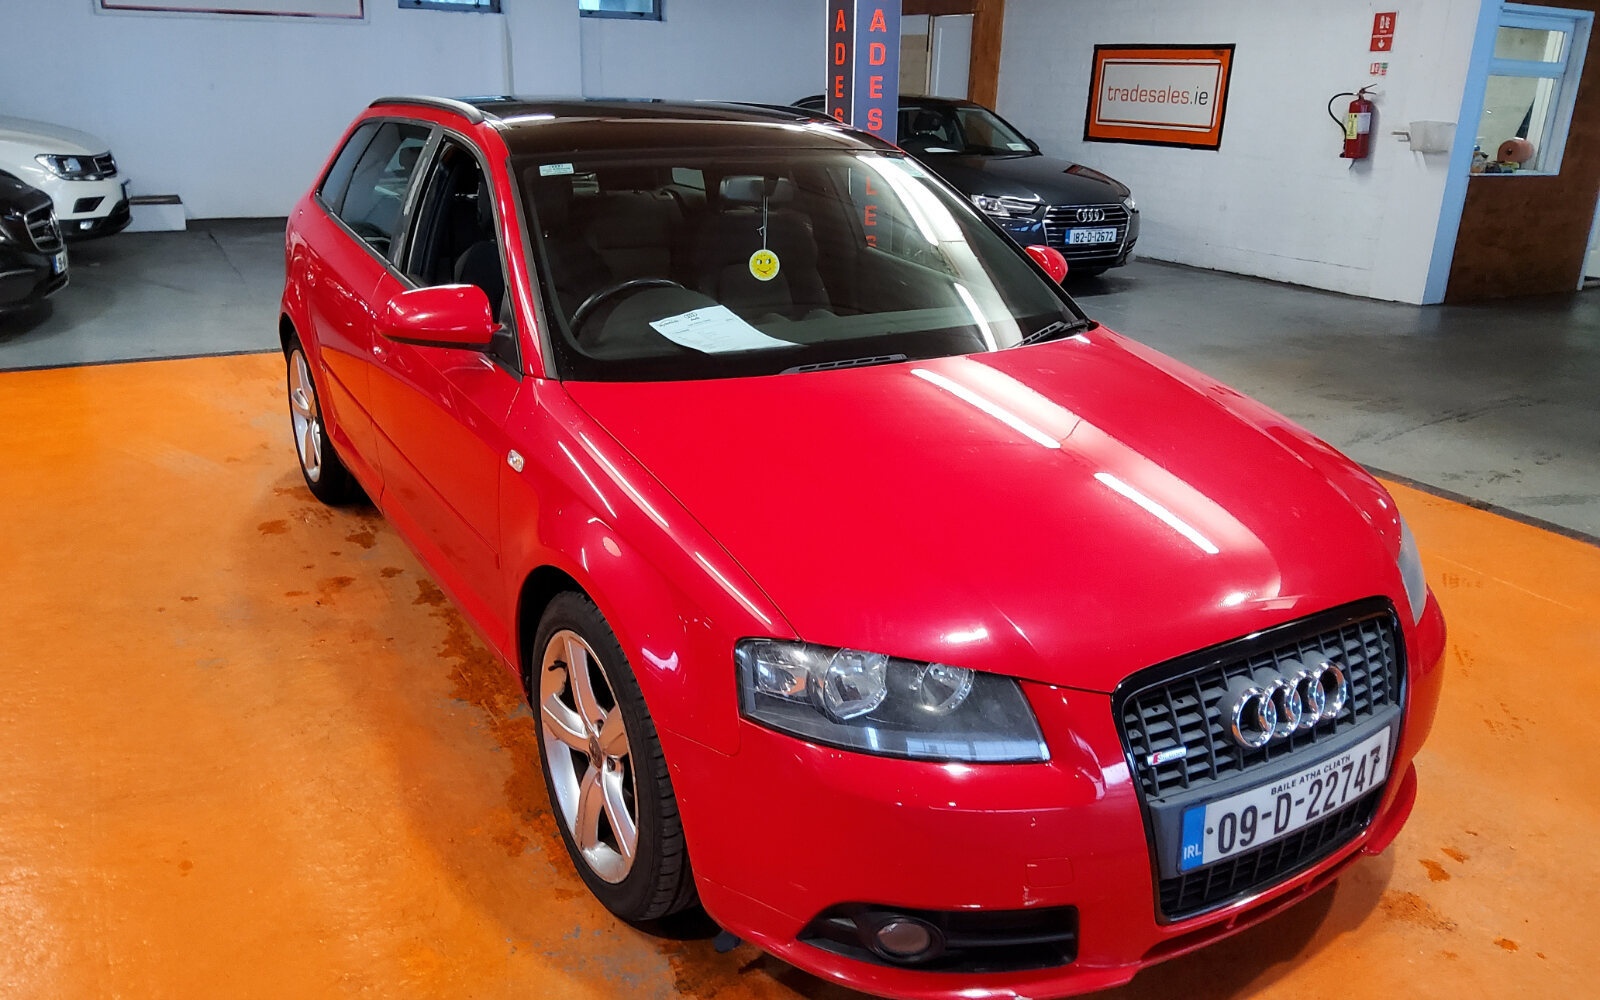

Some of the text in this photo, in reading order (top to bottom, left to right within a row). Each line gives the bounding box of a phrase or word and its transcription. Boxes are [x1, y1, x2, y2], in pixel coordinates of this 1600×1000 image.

[1107, 84, 1209, 106] tradesales.ie
[1073, 231, 1114, 243] 182-D-12672
[1270, 780, 1297, 796] BAILE
[1323, 755, 1352, 773] CLIATH
[1217, 745, 1381, 855] 09-D-22747
[1183, 843, 1202, 860] IRL
